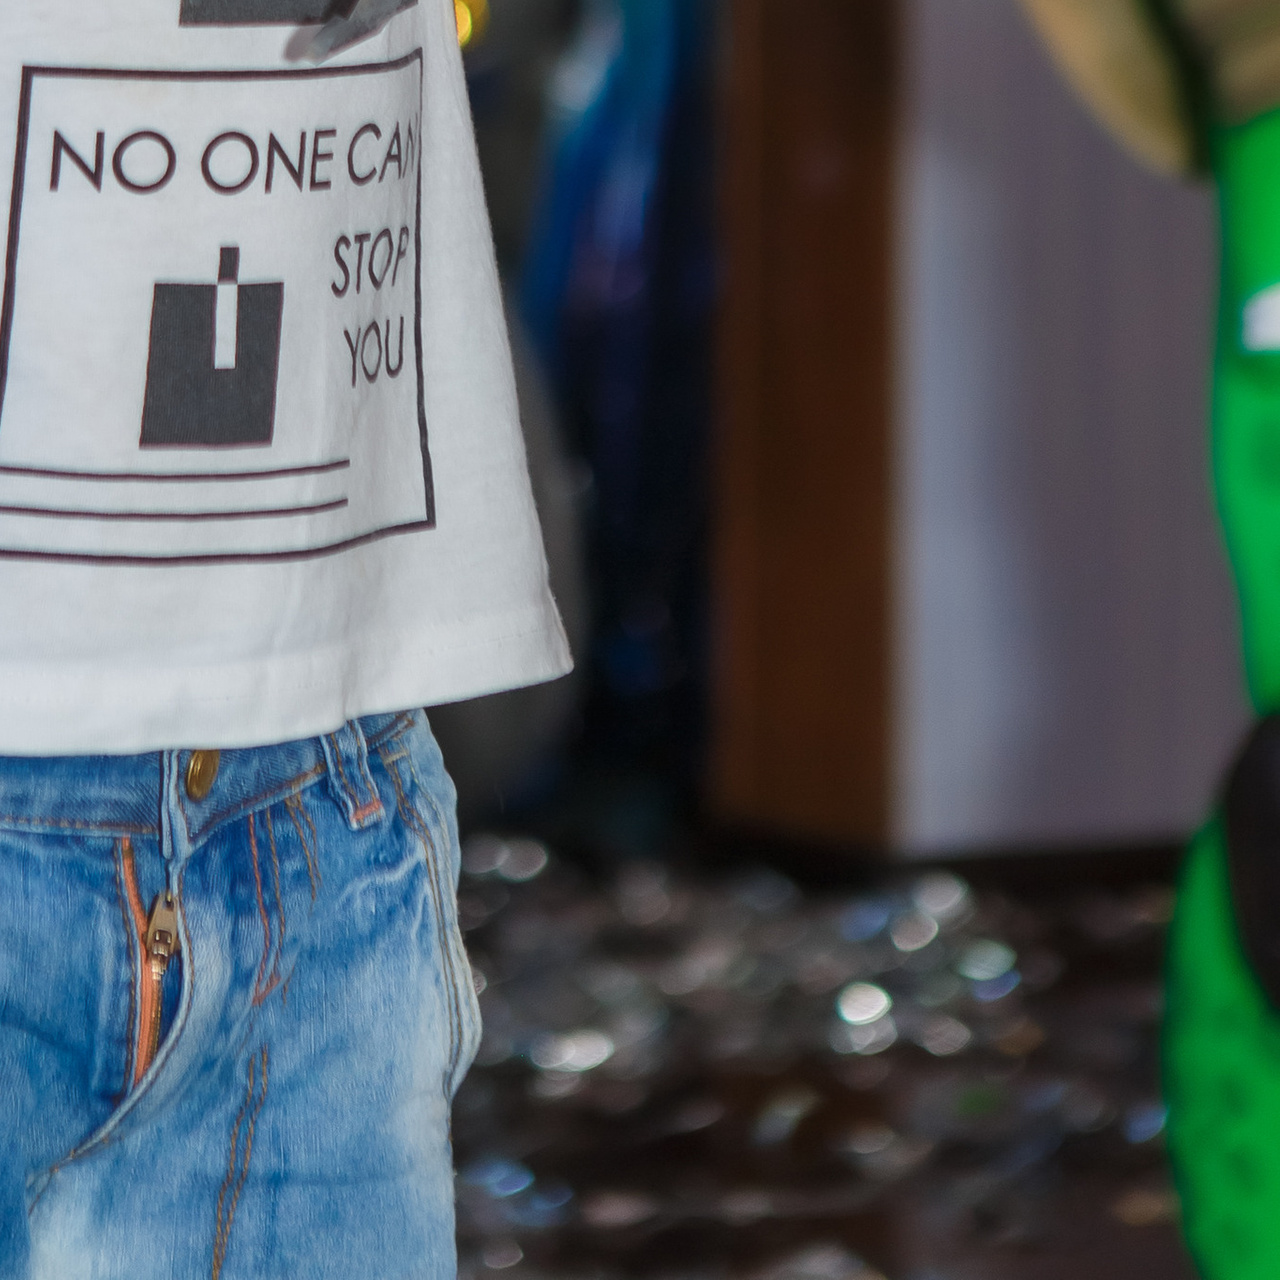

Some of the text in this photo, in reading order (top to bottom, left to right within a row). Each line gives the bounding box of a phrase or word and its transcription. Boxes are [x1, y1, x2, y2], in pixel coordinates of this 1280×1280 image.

[50, 112, 419, 195] NO ONE CAN
[331, 226, 410, 299] STOP
[343, 315, 404, 389] YOU
